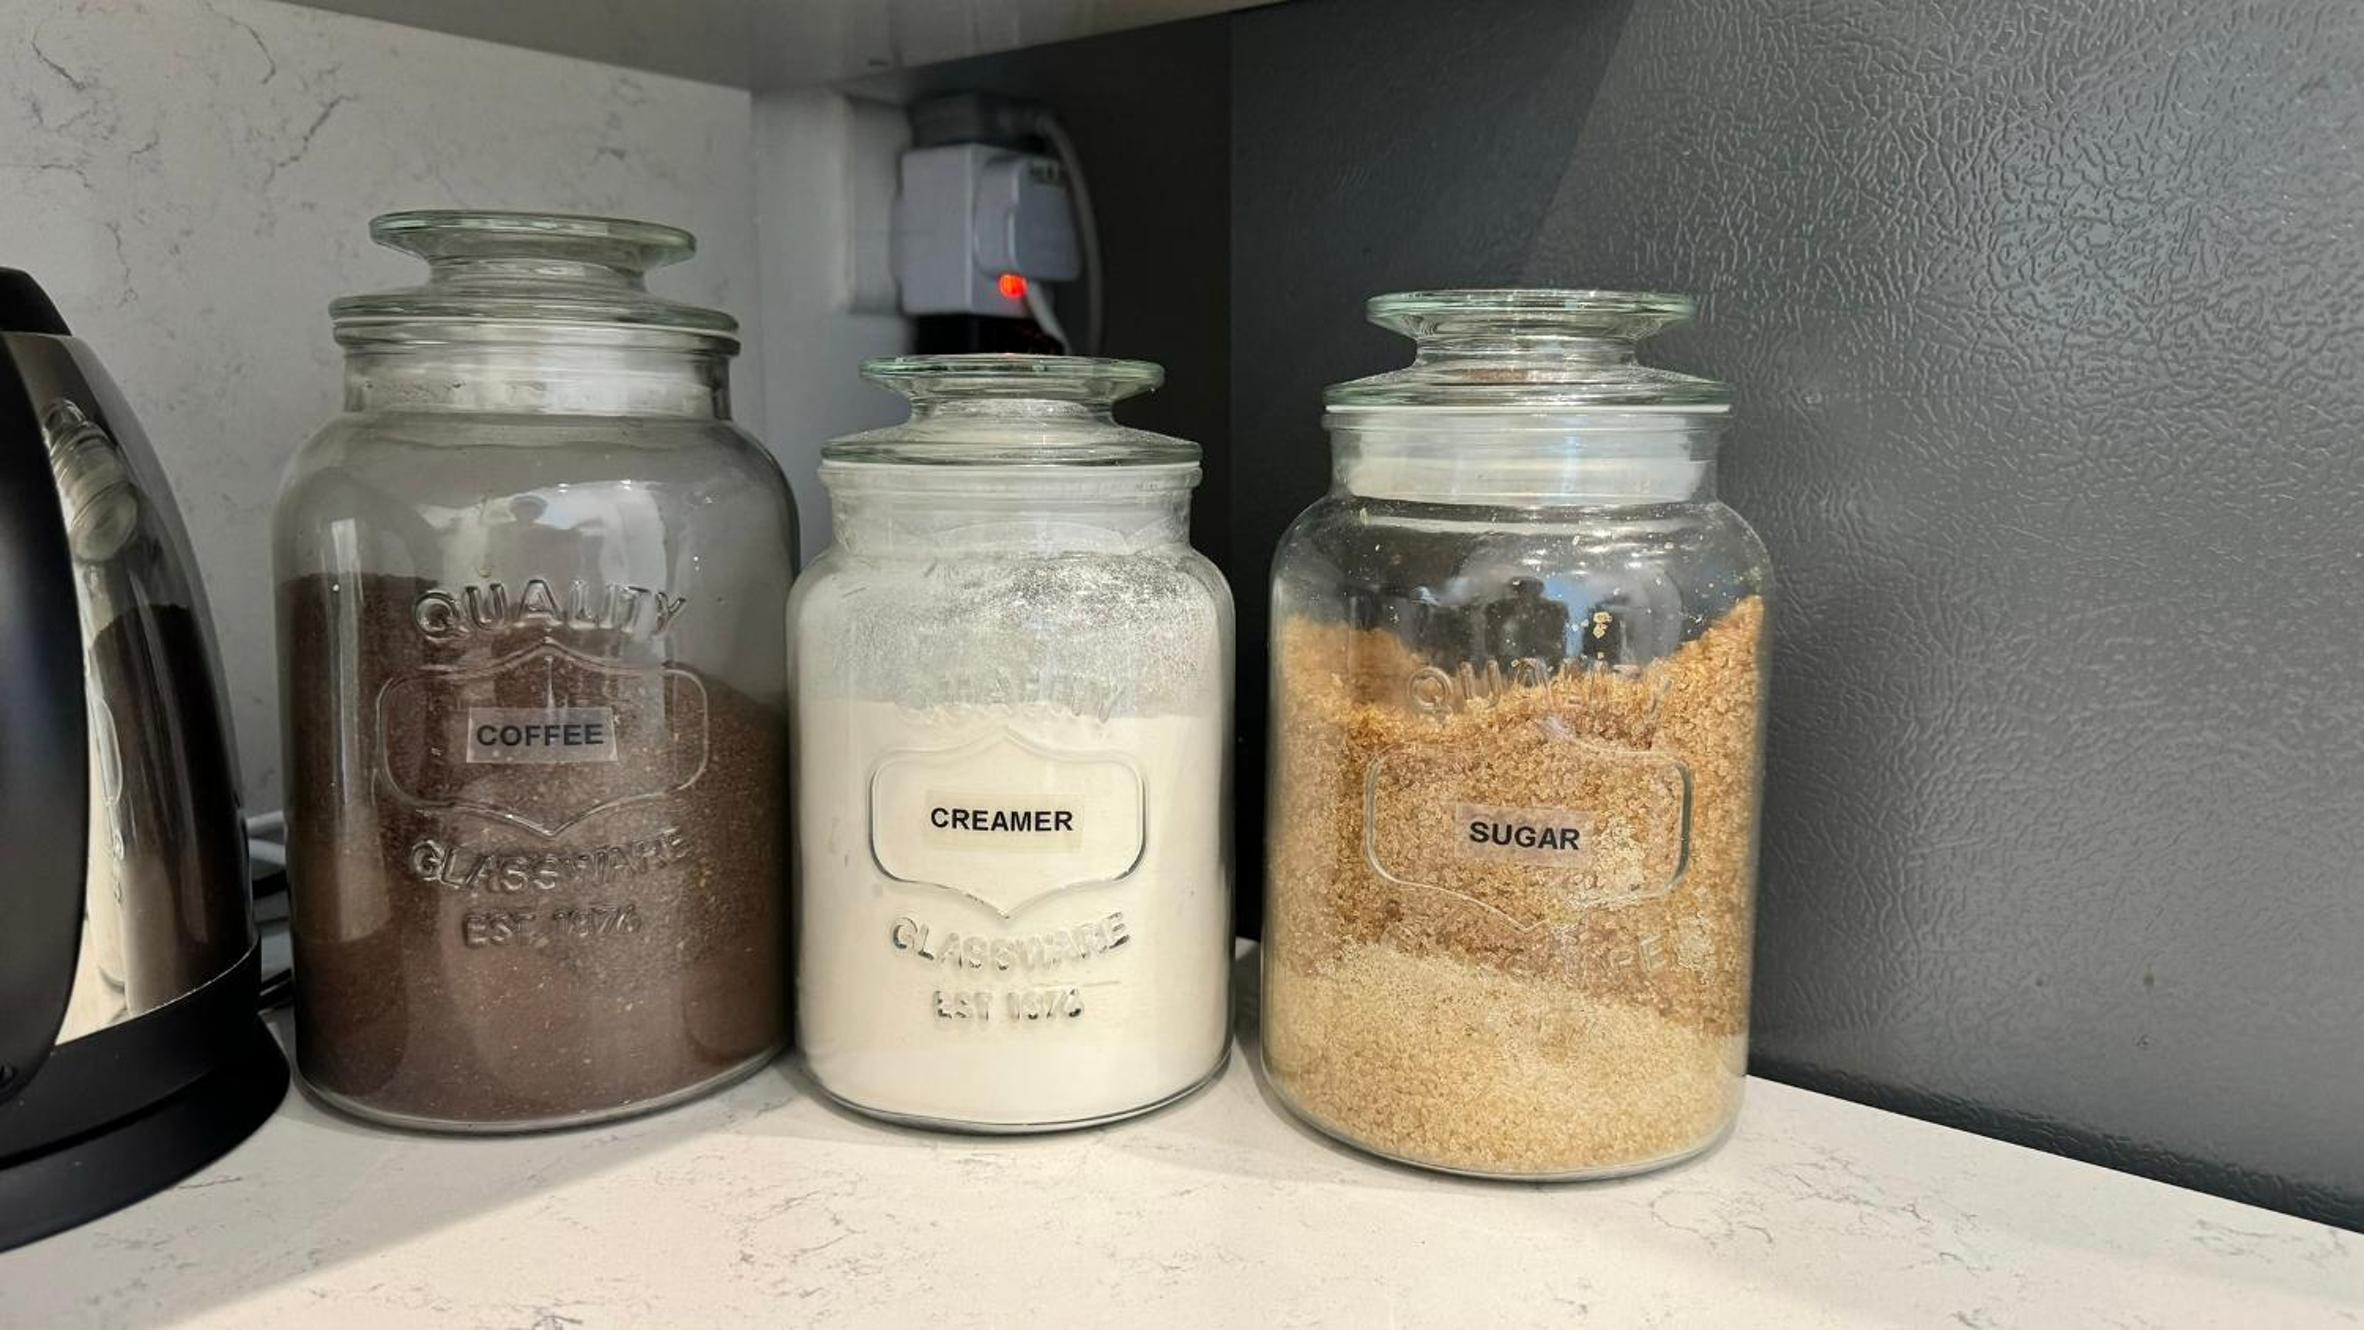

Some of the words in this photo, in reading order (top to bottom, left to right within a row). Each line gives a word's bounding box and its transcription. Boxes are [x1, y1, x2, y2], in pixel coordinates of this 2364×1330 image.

[414, 577, 686, 642] QUALITY
[476, 723, 604, 747] COFFEE
[930, 807, 1074, 833] CREAMER
[1469, 822, 1580, 850] SUGAR
